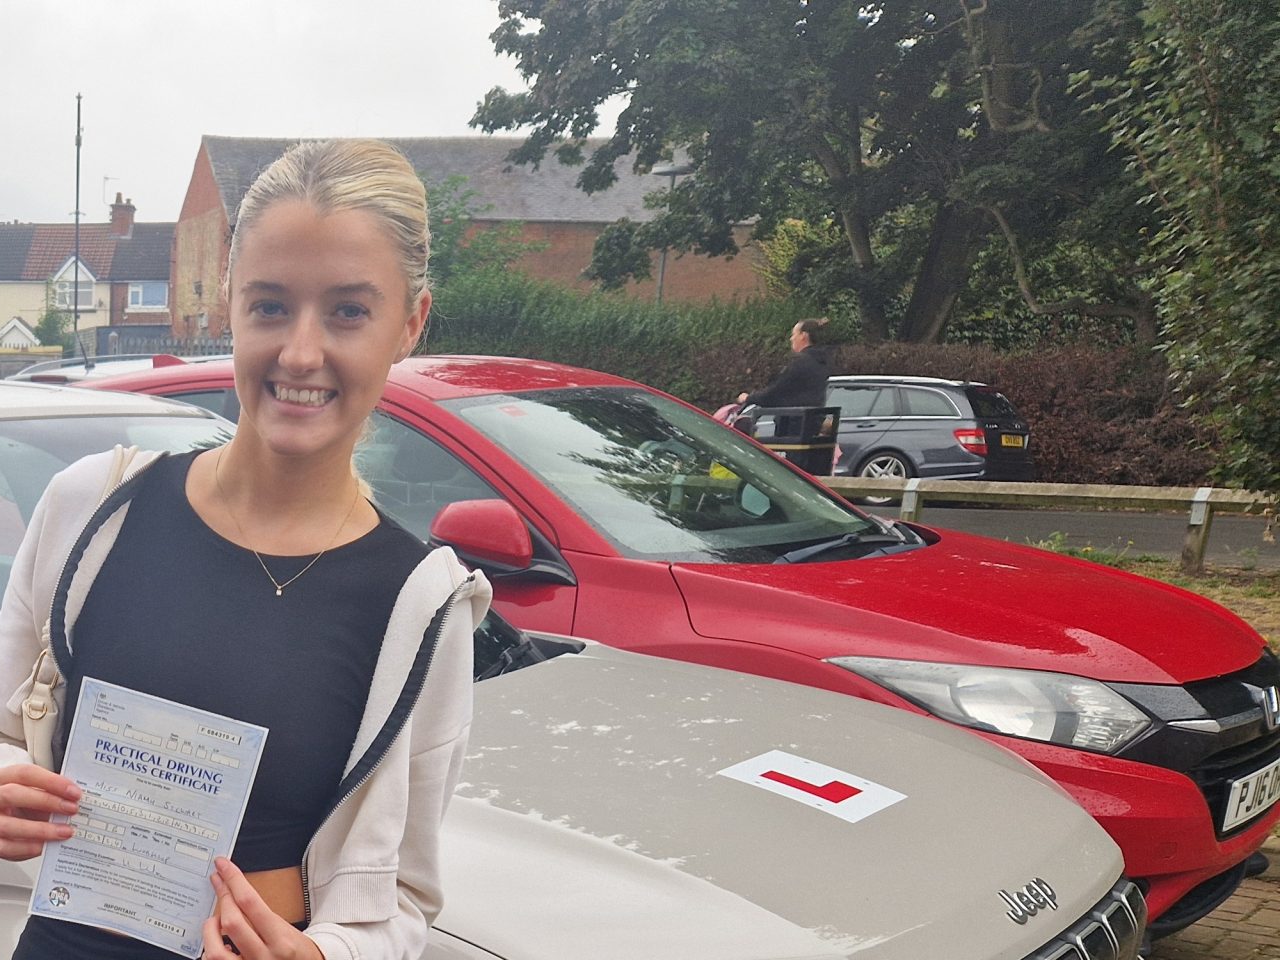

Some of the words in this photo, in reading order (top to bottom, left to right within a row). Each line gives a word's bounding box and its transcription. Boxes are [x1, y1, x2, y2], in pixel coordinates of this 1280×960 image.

[94, 751, 116, 764] TEST
[121, 759, 148, 774] PASS
[150, 767, 220, 795] CERTIFICATE
[95, 739, 162, 766] PRACTICAL
[166, 760, 223, 783] DRIVING
[760, 770, 863, 804] L
[1235, 771, 1270, 818] PJ16
[104, 903, 137, 917] IMPORTANT
[997, 877, 1058, 925] Jeep
